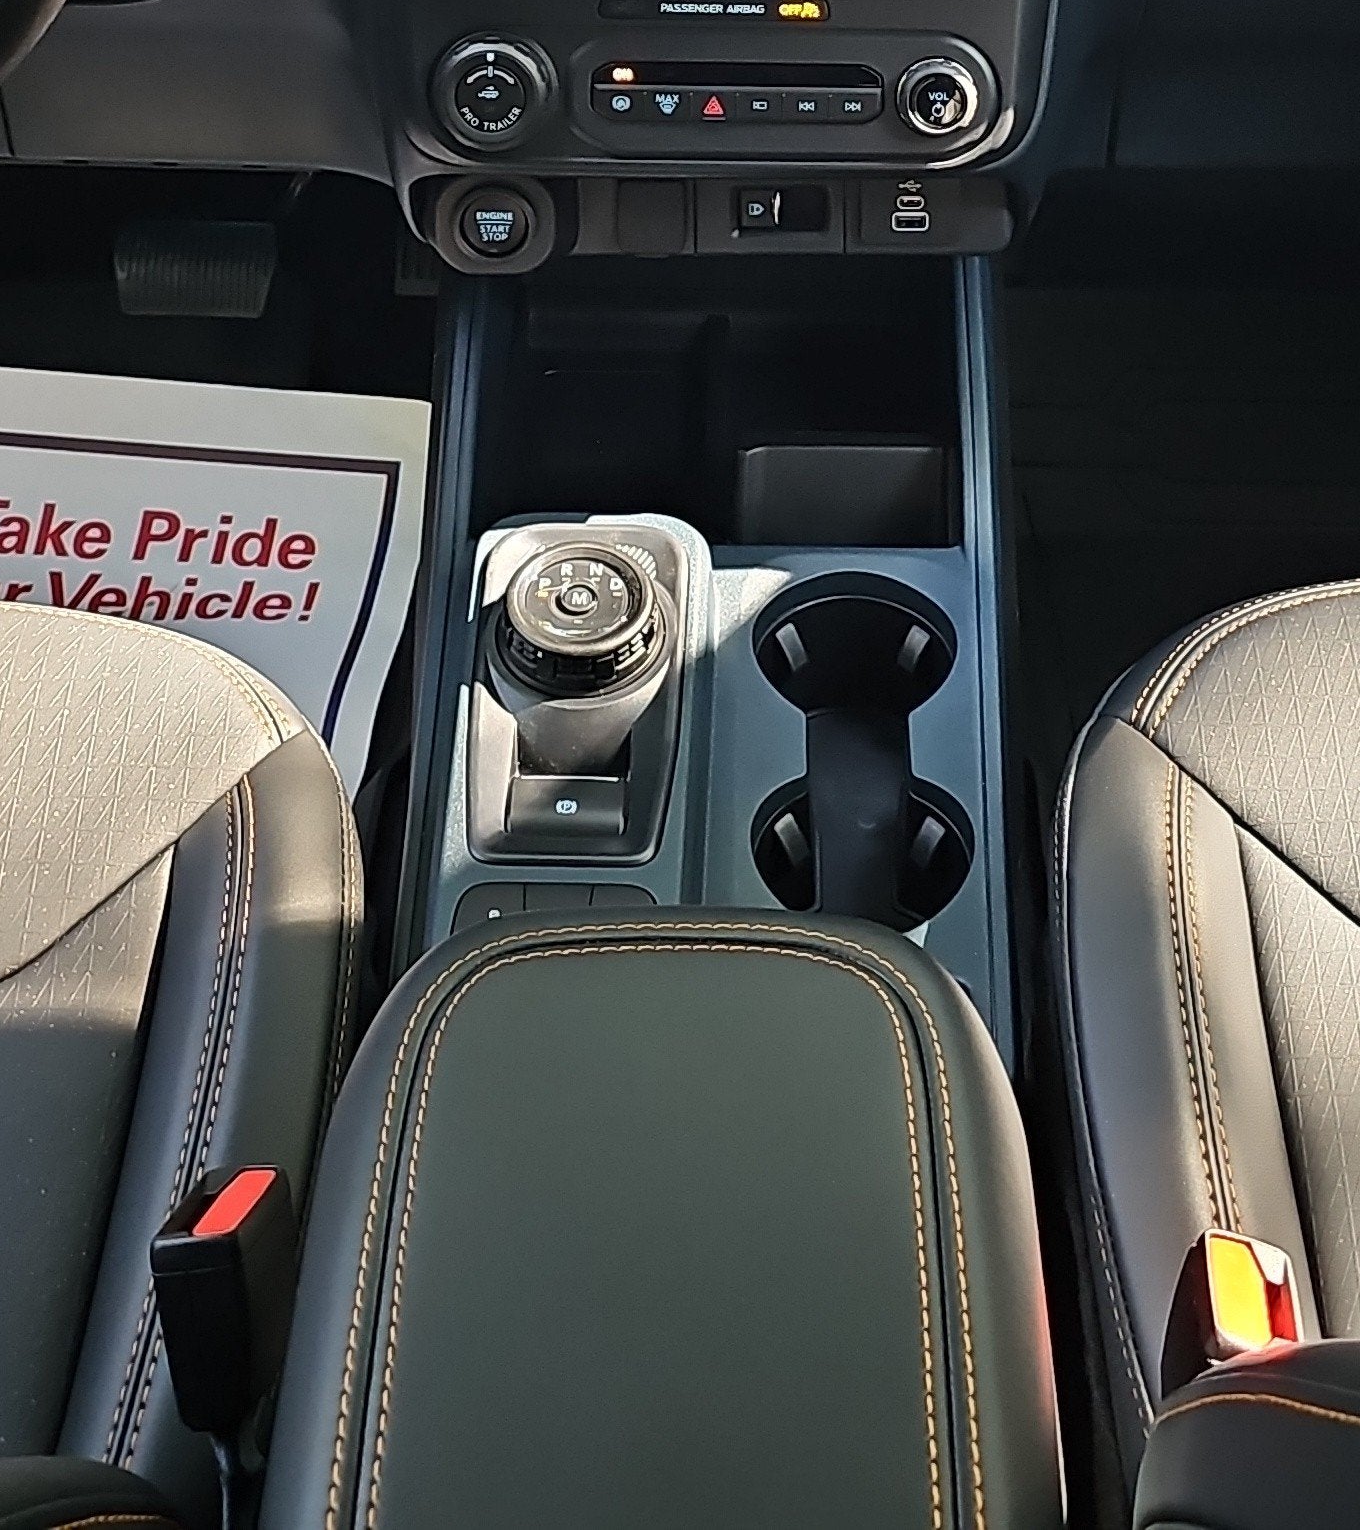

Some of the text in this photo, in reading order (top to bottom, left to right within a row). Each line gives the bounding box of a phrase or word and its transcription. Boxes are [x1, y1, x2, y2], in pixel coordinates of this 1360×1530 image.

[660, 3, 801, 17] PASSENGER AIRBAG OFF
[656, 93, 680, 104] MAX
[928, 92, 950, 101] VOL
[460, 107, 522, 131] PRO TRAILER
[476, 212, 514, 221] ENGINE
[480, 225, 510, 233] START
[482, 233, 508, 242] STOP
[132, 510, 316, 570] Pride
[561, 563, 573, 576] R
[590, 563, 604, 576] N
[539, 578, 551, 590] P
[610, 578, 623, 590] D
[49, 571, 321, 621] Vehicle!
[572, 592, 588, 605] M
